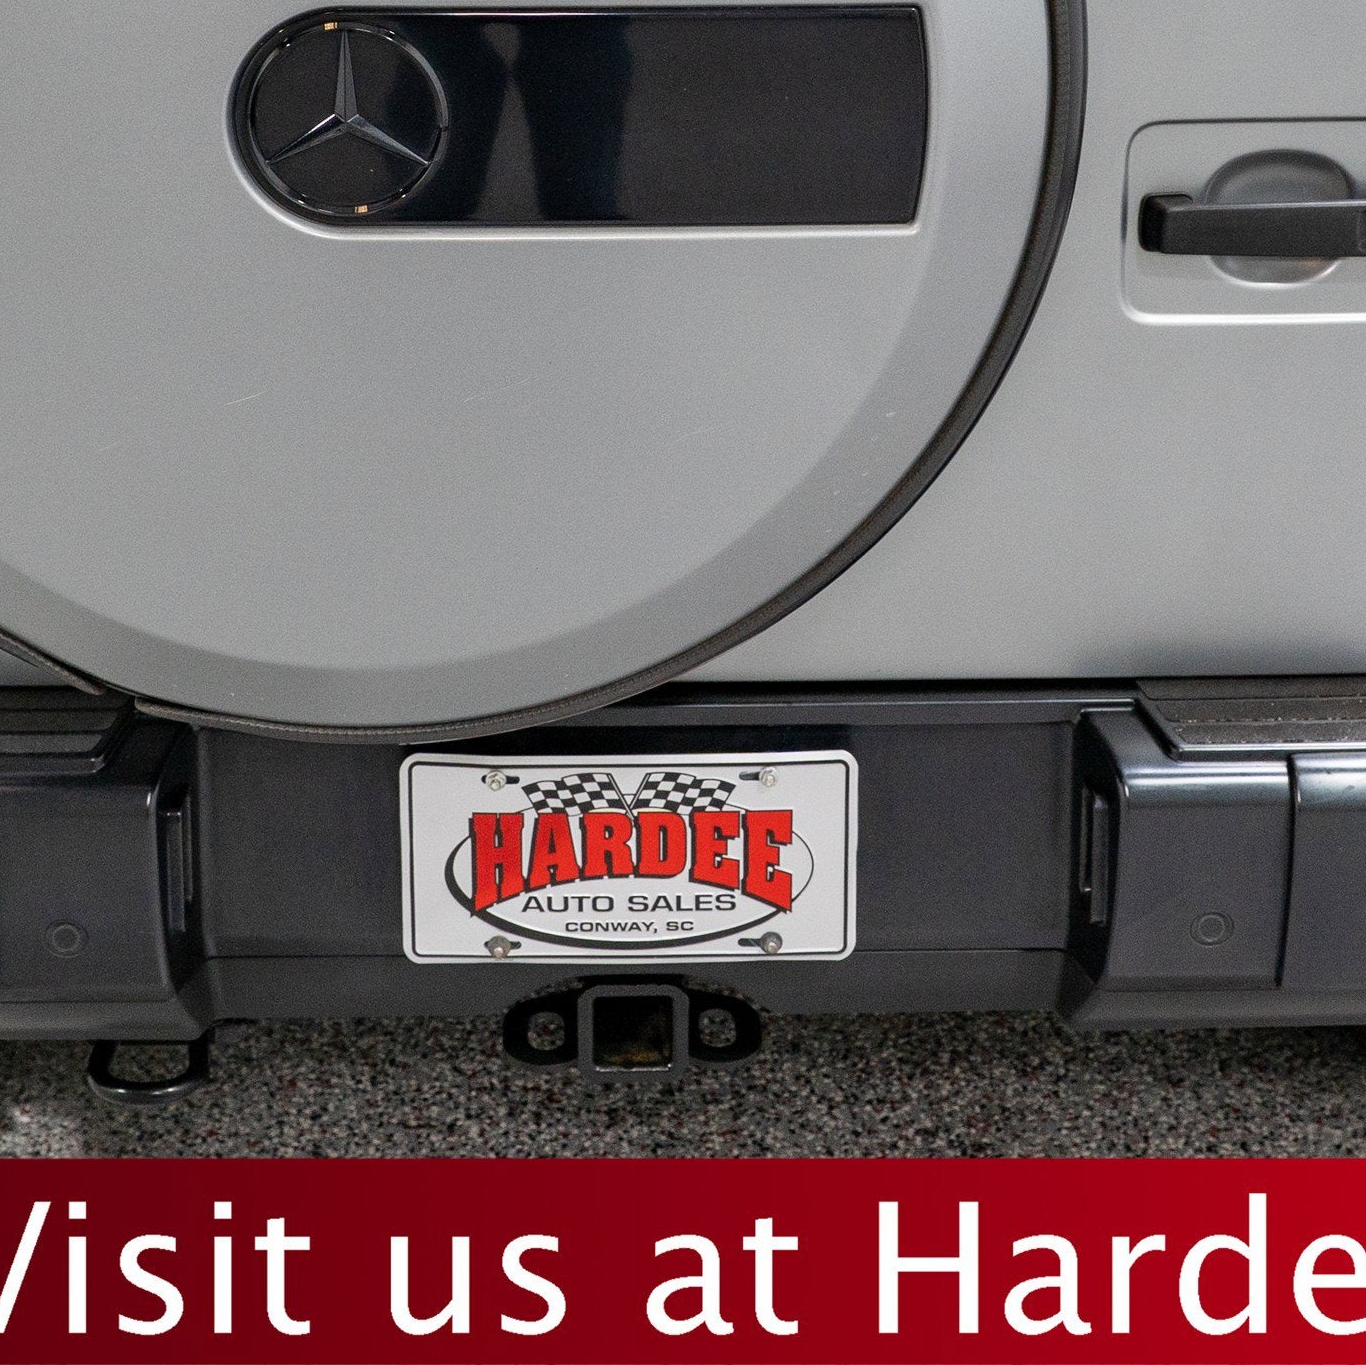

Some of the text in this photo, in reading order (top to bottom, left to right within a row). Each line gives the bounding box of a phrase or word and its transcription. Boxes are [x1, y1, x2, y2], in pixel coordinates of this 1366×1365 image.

[469, 809, 793, 917] HARDEE
[521, 893, 737, 914] AUTO SALES
[564, 920, 695, 934] CONWAY, SC
